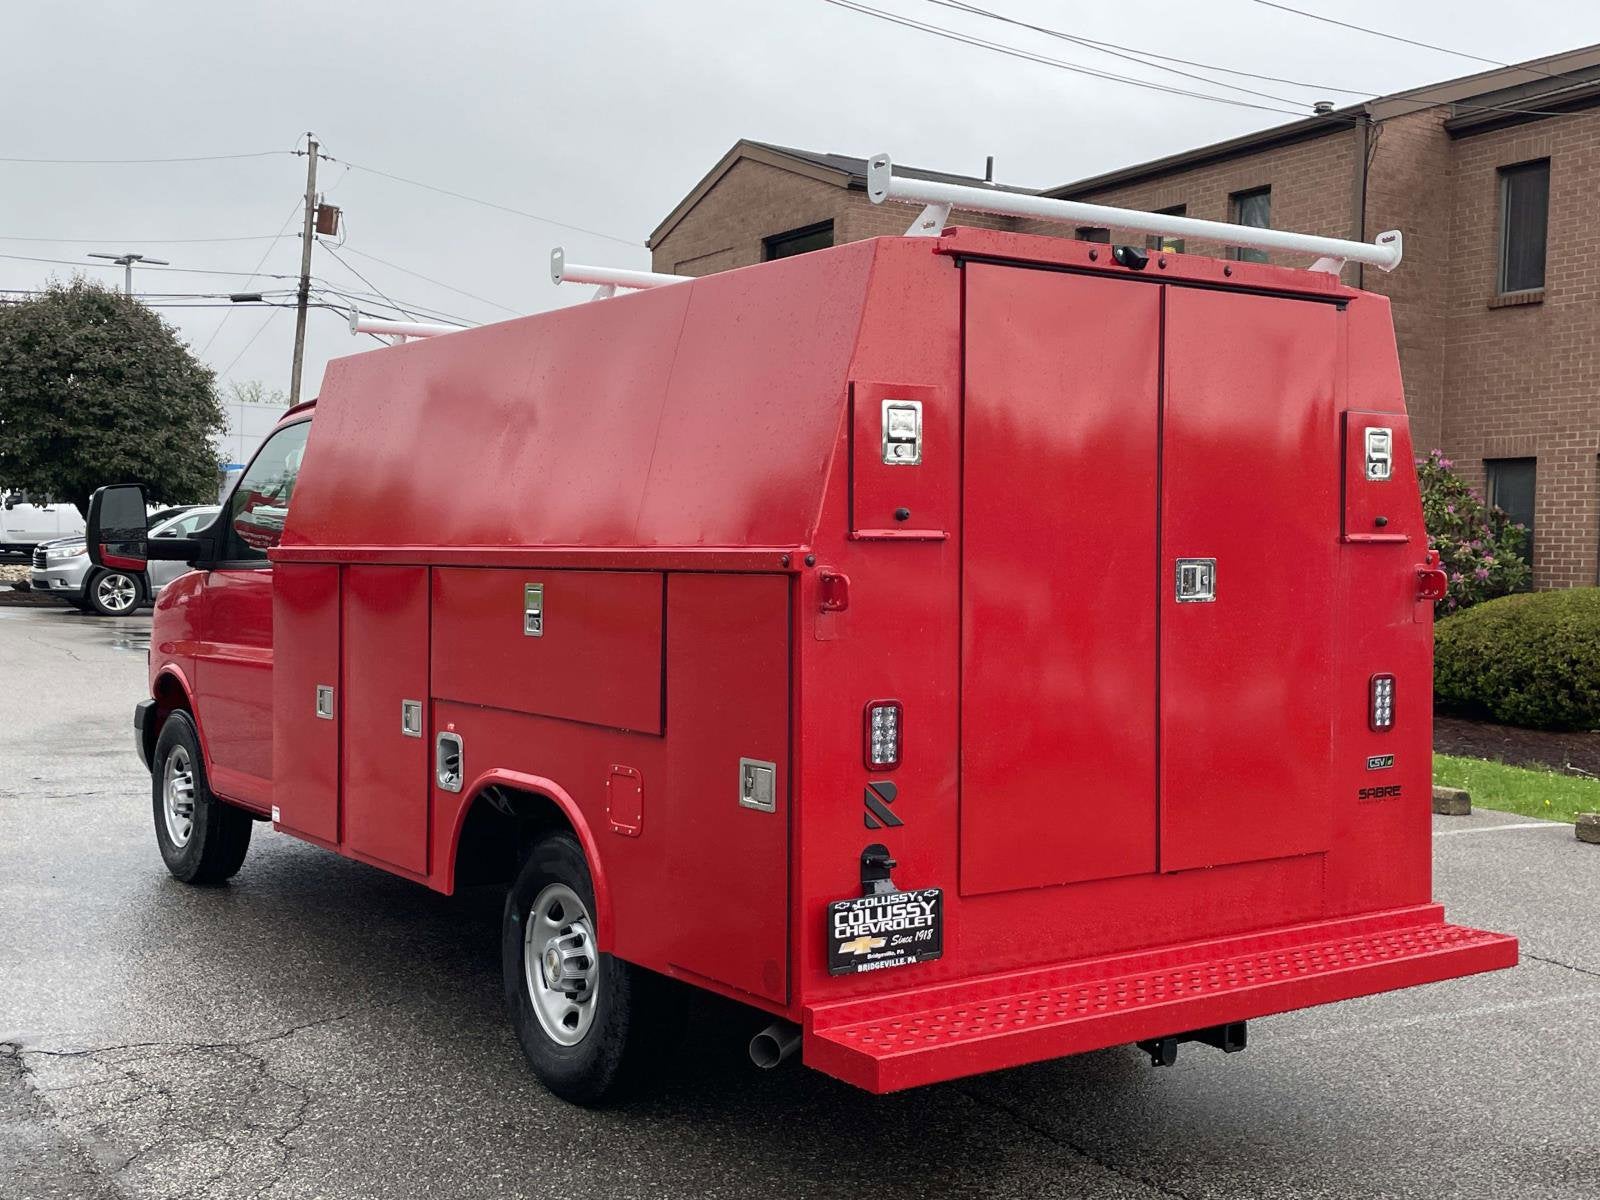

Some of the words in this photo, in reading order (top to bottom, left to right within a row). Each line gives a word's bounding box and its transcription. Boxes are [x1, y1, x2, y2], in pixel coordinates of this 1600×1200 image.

[1369, 758, 1386, 768] CSV
[1358, 785, 1402, 800] SABRE
[835, 900, 936, 928] COLUSSY
[835, 914, 935, 938] CHEVROLET
[891, 935, 913, 946] Since
[915, 929, 934, 942] 1918
[907, 955, 917, 964] PA
